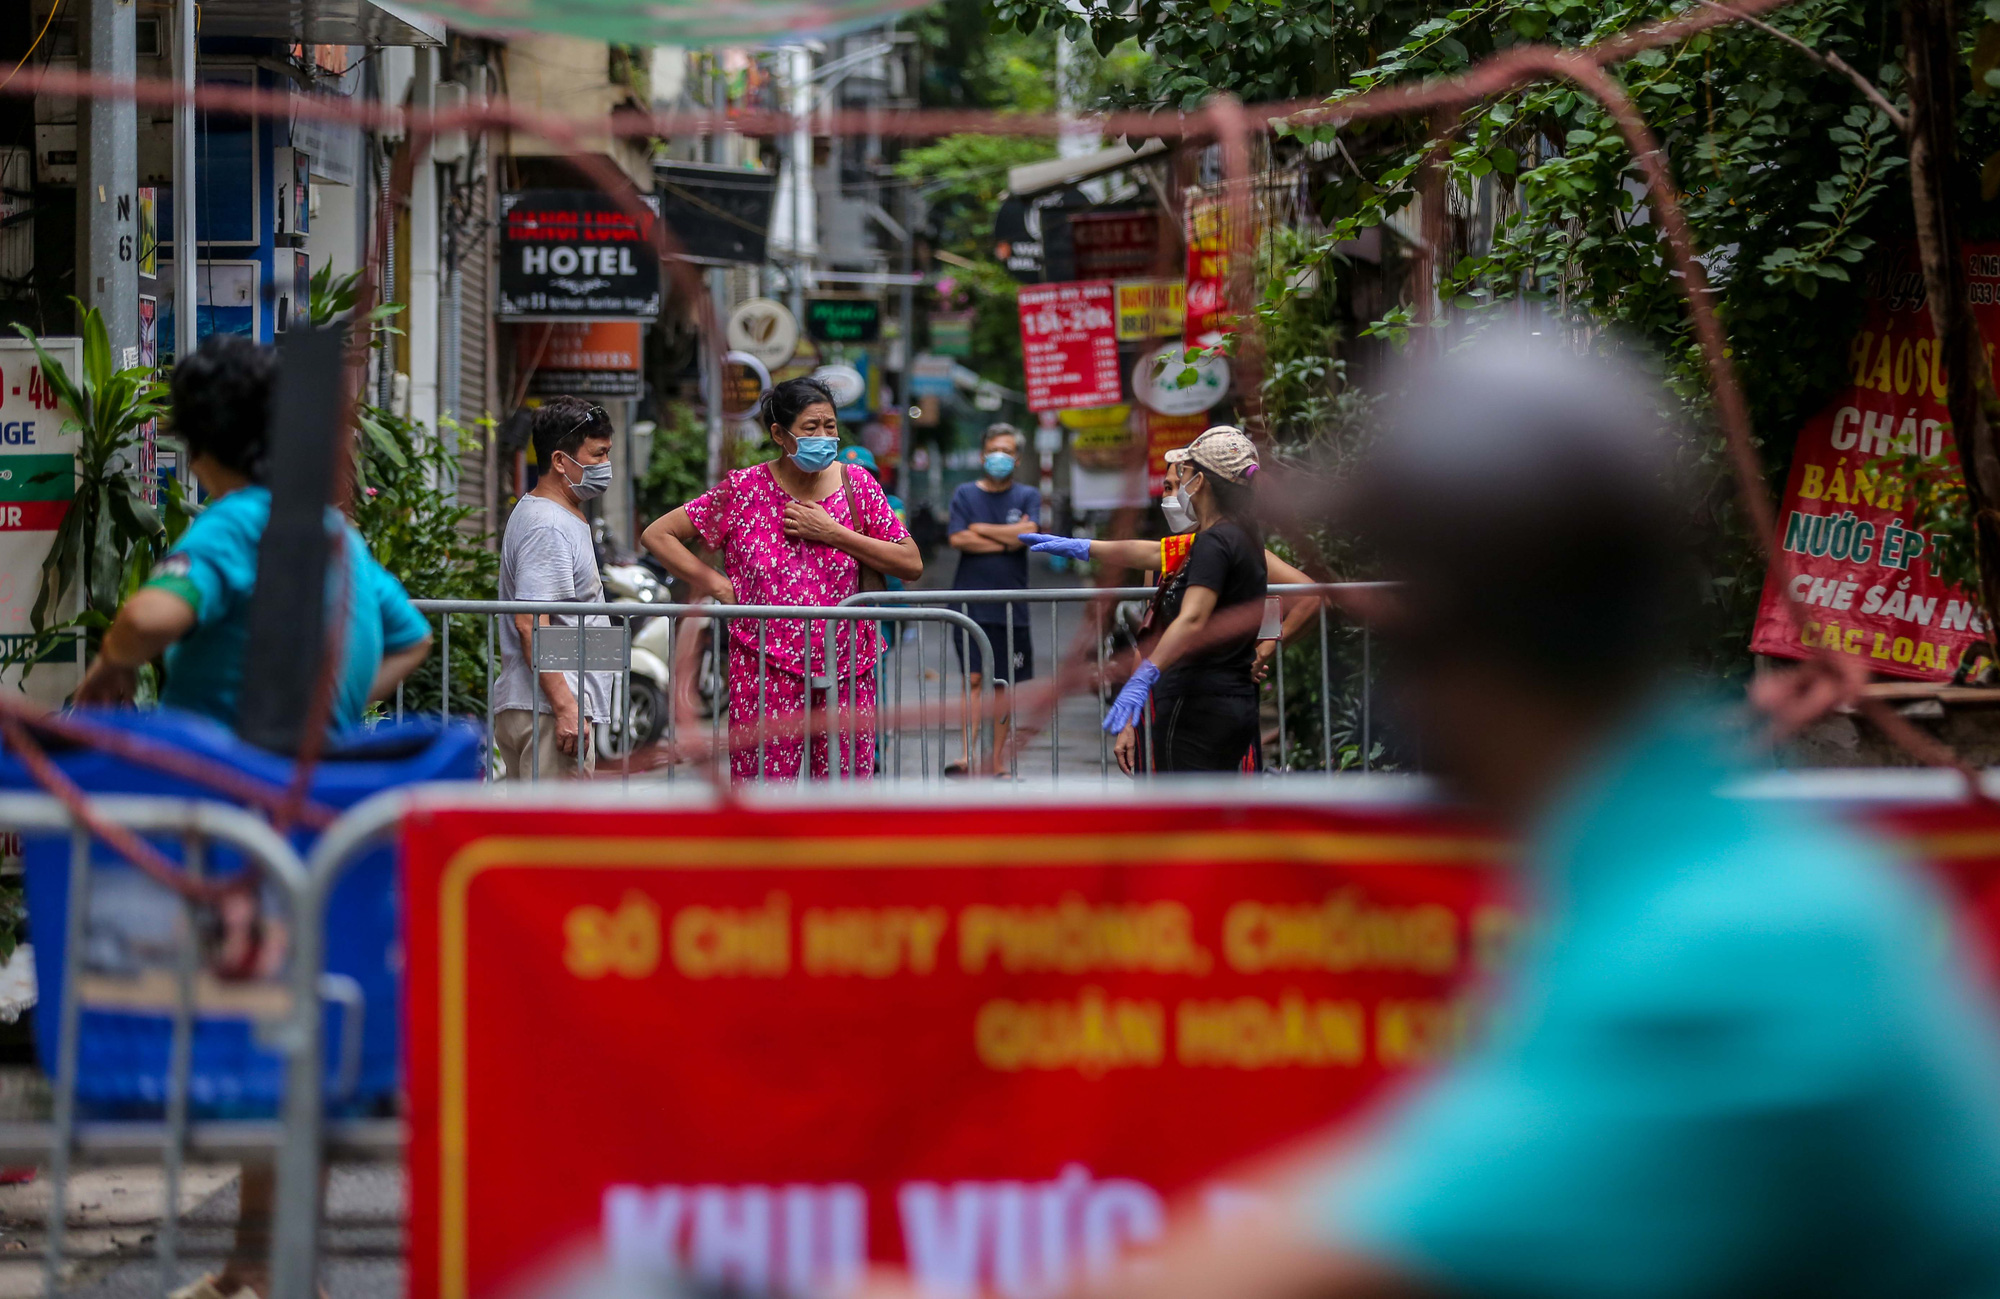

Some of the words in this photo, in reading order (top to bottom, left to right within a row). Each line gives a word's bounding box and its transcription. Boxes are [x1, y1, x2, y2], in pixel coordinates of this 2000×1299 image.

[118, 194, 130, 222] N
[119, 235, 132, 262] 6
[522, 246, 638, 276] HOTEL
[1979, 254, 2000, 278] NG
[0, 421, 36, 445] GE
[1831, 407, 1943, 464] CHÁO
[1783, 511, 1875, 564] NƯỚC
[1879, 518, 1924, 570] ÉP
[1788, 574, 1859, 610] CHÈ
[1801, 621, 1863, 655] CÁC
[1870, 632, 1950, 672] LOẠI
[0, 832, 24, 857] IC
[802, 904, 948, 978] HUY
[604, 1183, 866, 1299] KHU
